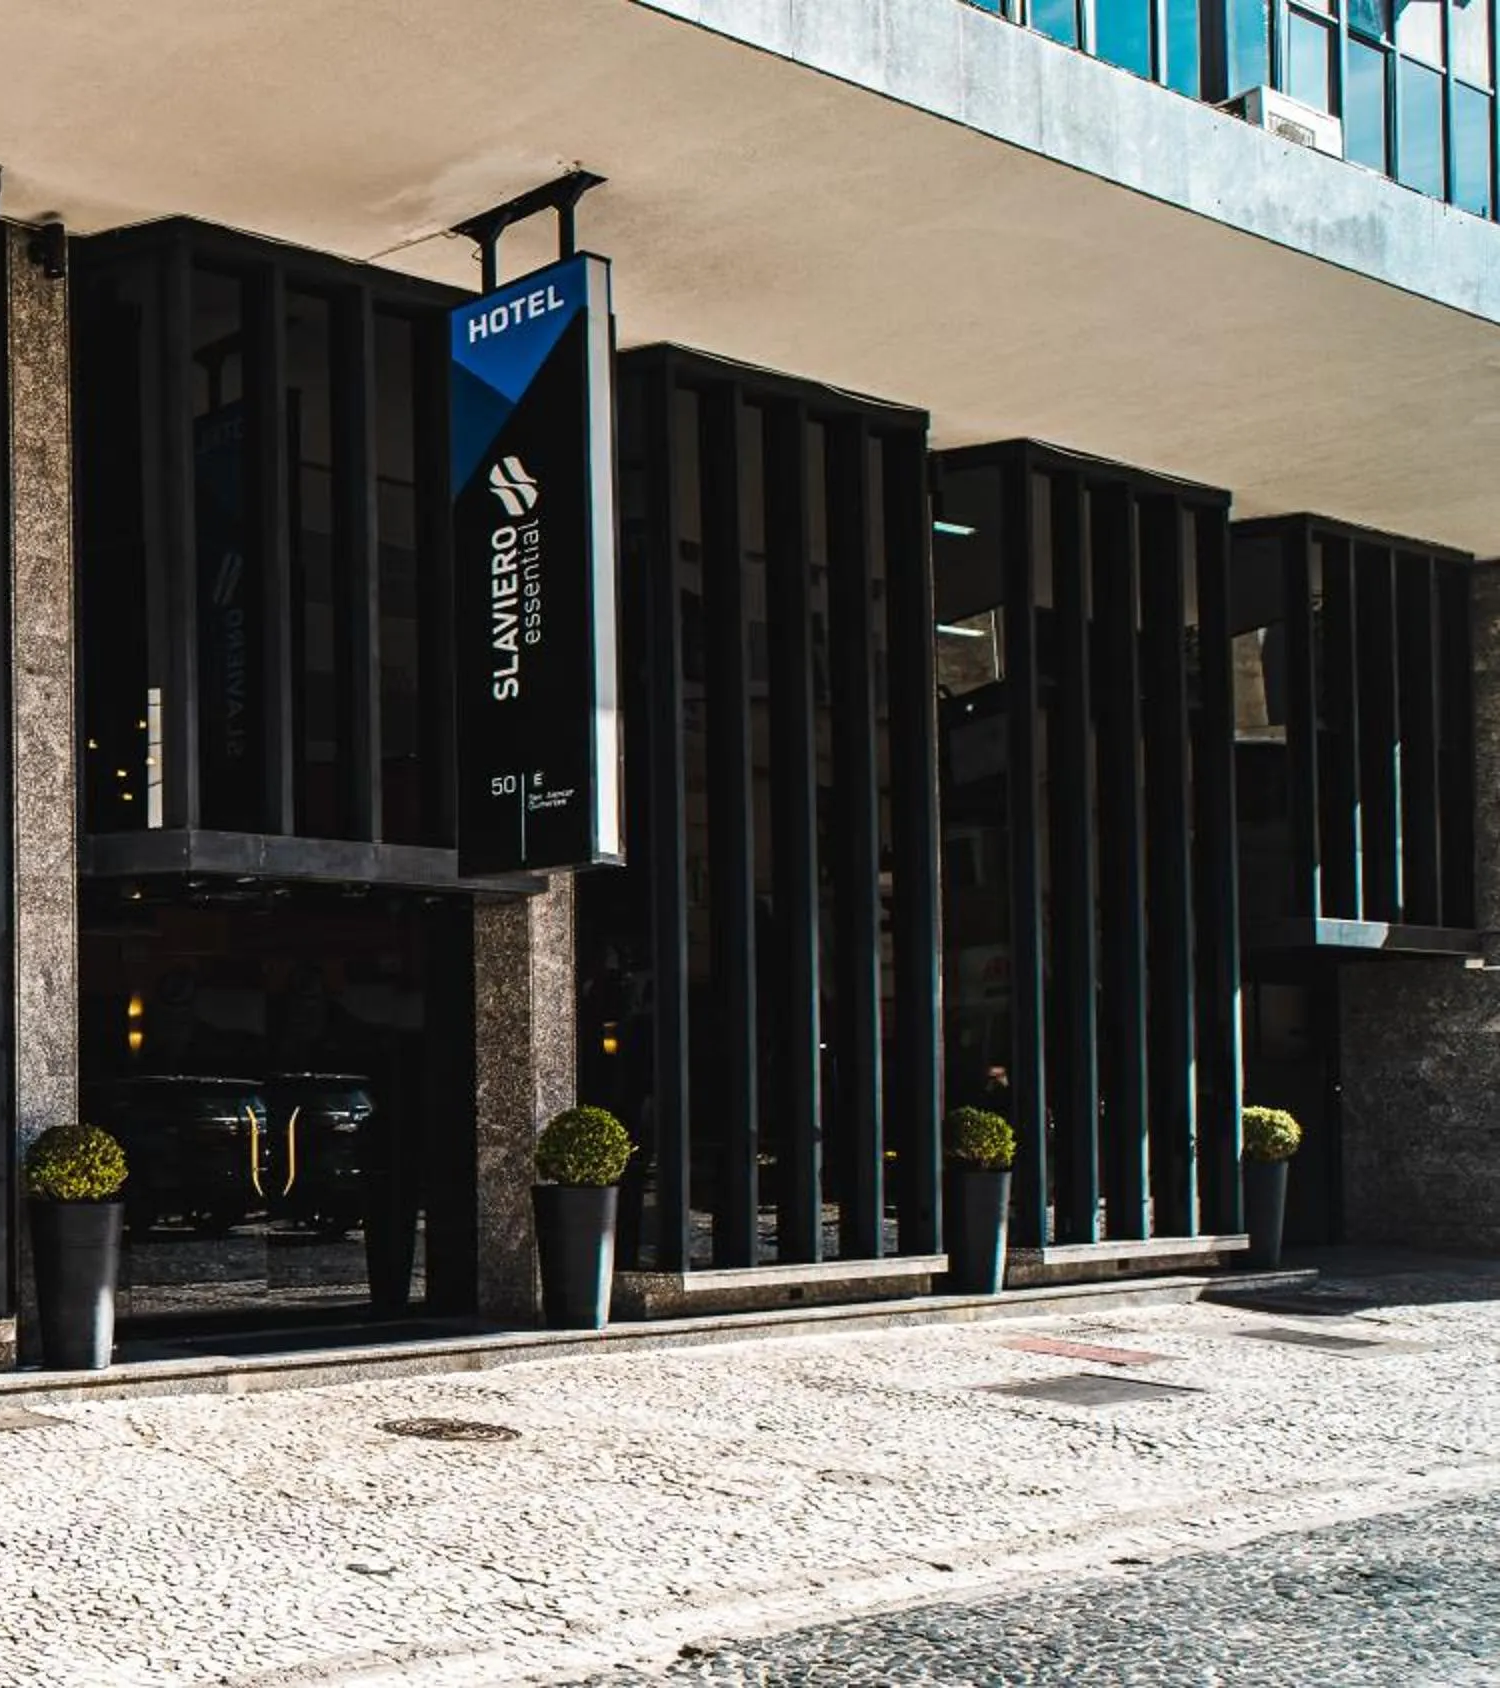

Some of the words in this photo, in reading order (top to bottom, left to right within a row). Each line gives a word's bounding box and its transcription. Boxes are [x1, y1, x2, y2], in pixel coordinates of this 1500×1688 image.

[468, 284, 565, 343] HOTEL
[491, 525, 520, 701] SLAVIERO
[518, 519, 541, 645] essential
[491, 775, 517, 795] 50
